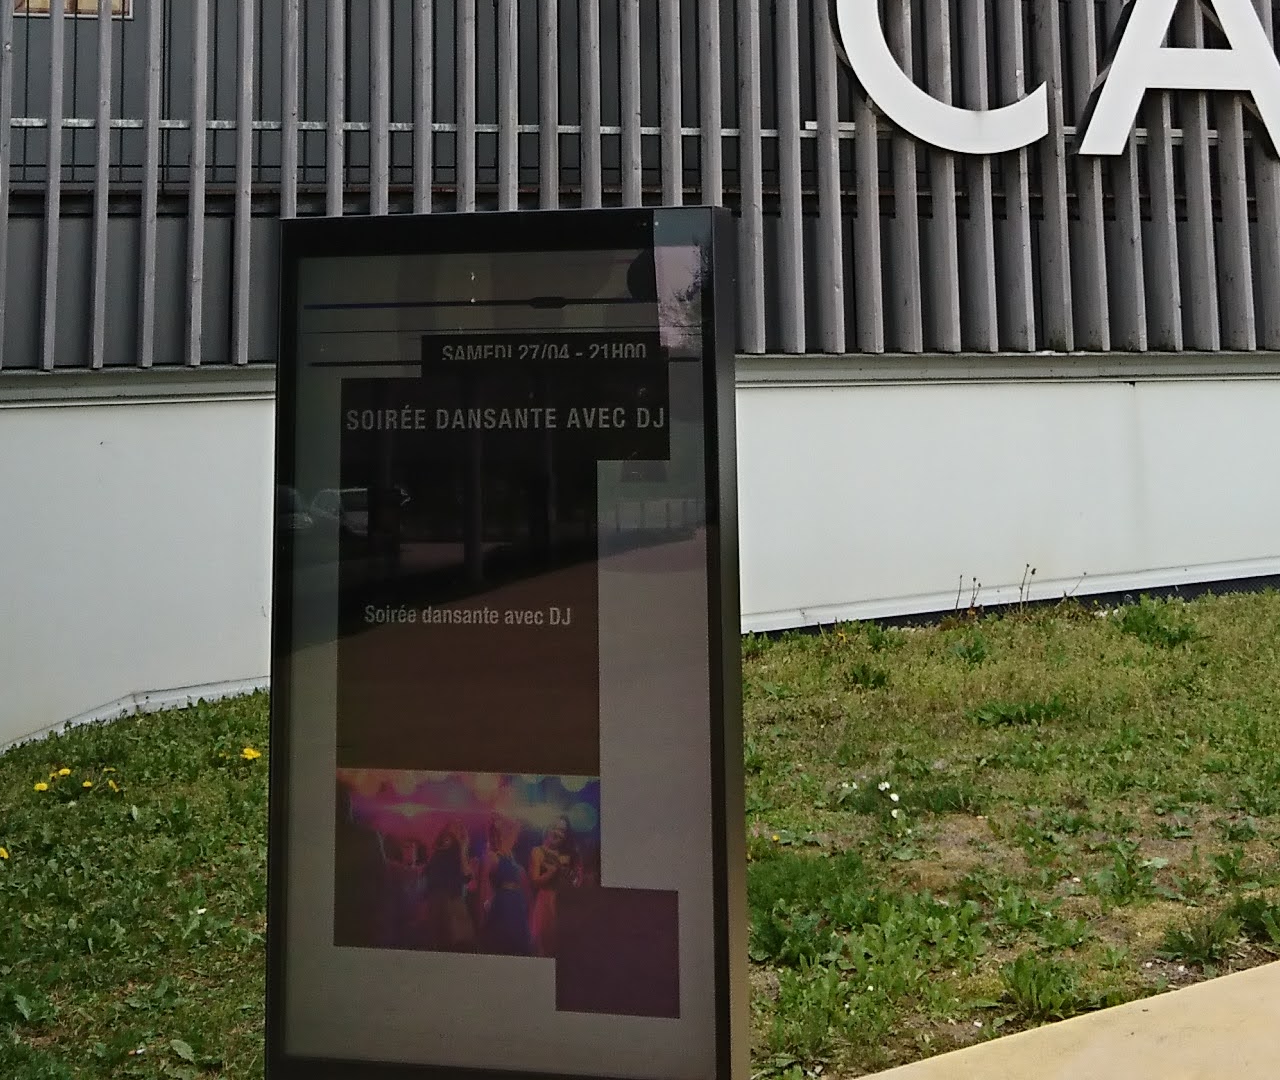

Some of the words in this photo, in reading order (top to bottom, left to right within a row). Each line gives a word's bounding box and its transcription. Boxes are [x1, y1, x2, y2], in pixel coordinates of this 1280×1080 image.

[441, 343, 512, 361] SAMEDI
[517, 343, 570, 360] 27/04
[346, 404, 426, 431] SOIRÉE
[436, 407, 557, 430] DANSANTE
[567, 407, 626, 429] AVEC
[637, 407, 665, 429] DJ
[365, 604, 417, 624] Soirée
[422, 605, 499, 625] dansante
[504, 610, 544, 625] avec
[549, 607, 572, 626] DJ
